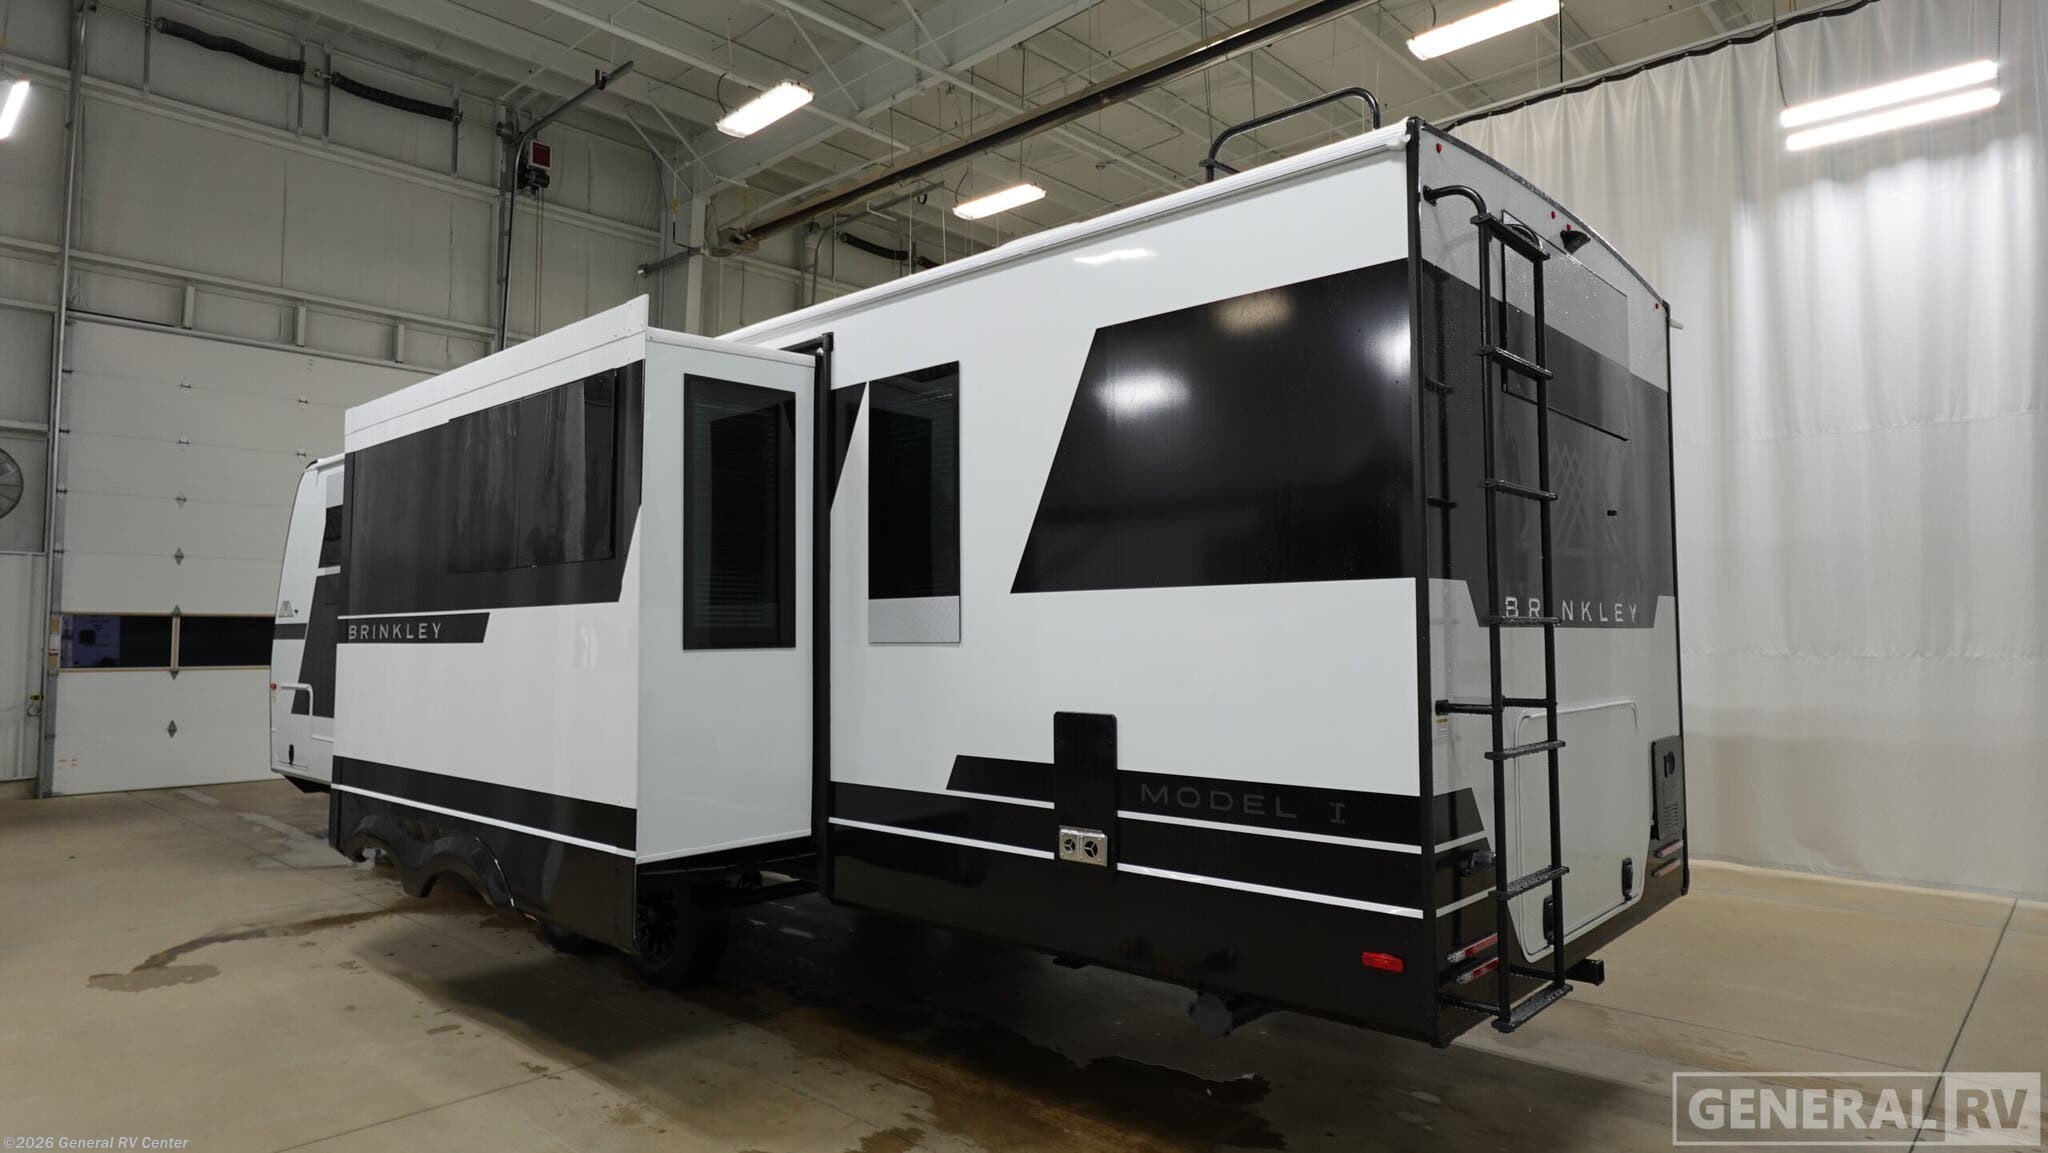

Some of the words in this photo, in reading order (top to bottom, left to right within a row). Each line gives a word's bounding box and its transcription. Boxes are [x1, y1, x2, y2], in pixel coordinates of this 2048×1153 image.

[1505, 596, 1637, 622] BRNKLEY
[349, 623, 442, 640] BRINKLEY
[1141, 783, 1297, 819] MODEL
[1330, 802, 1346, 824] I
